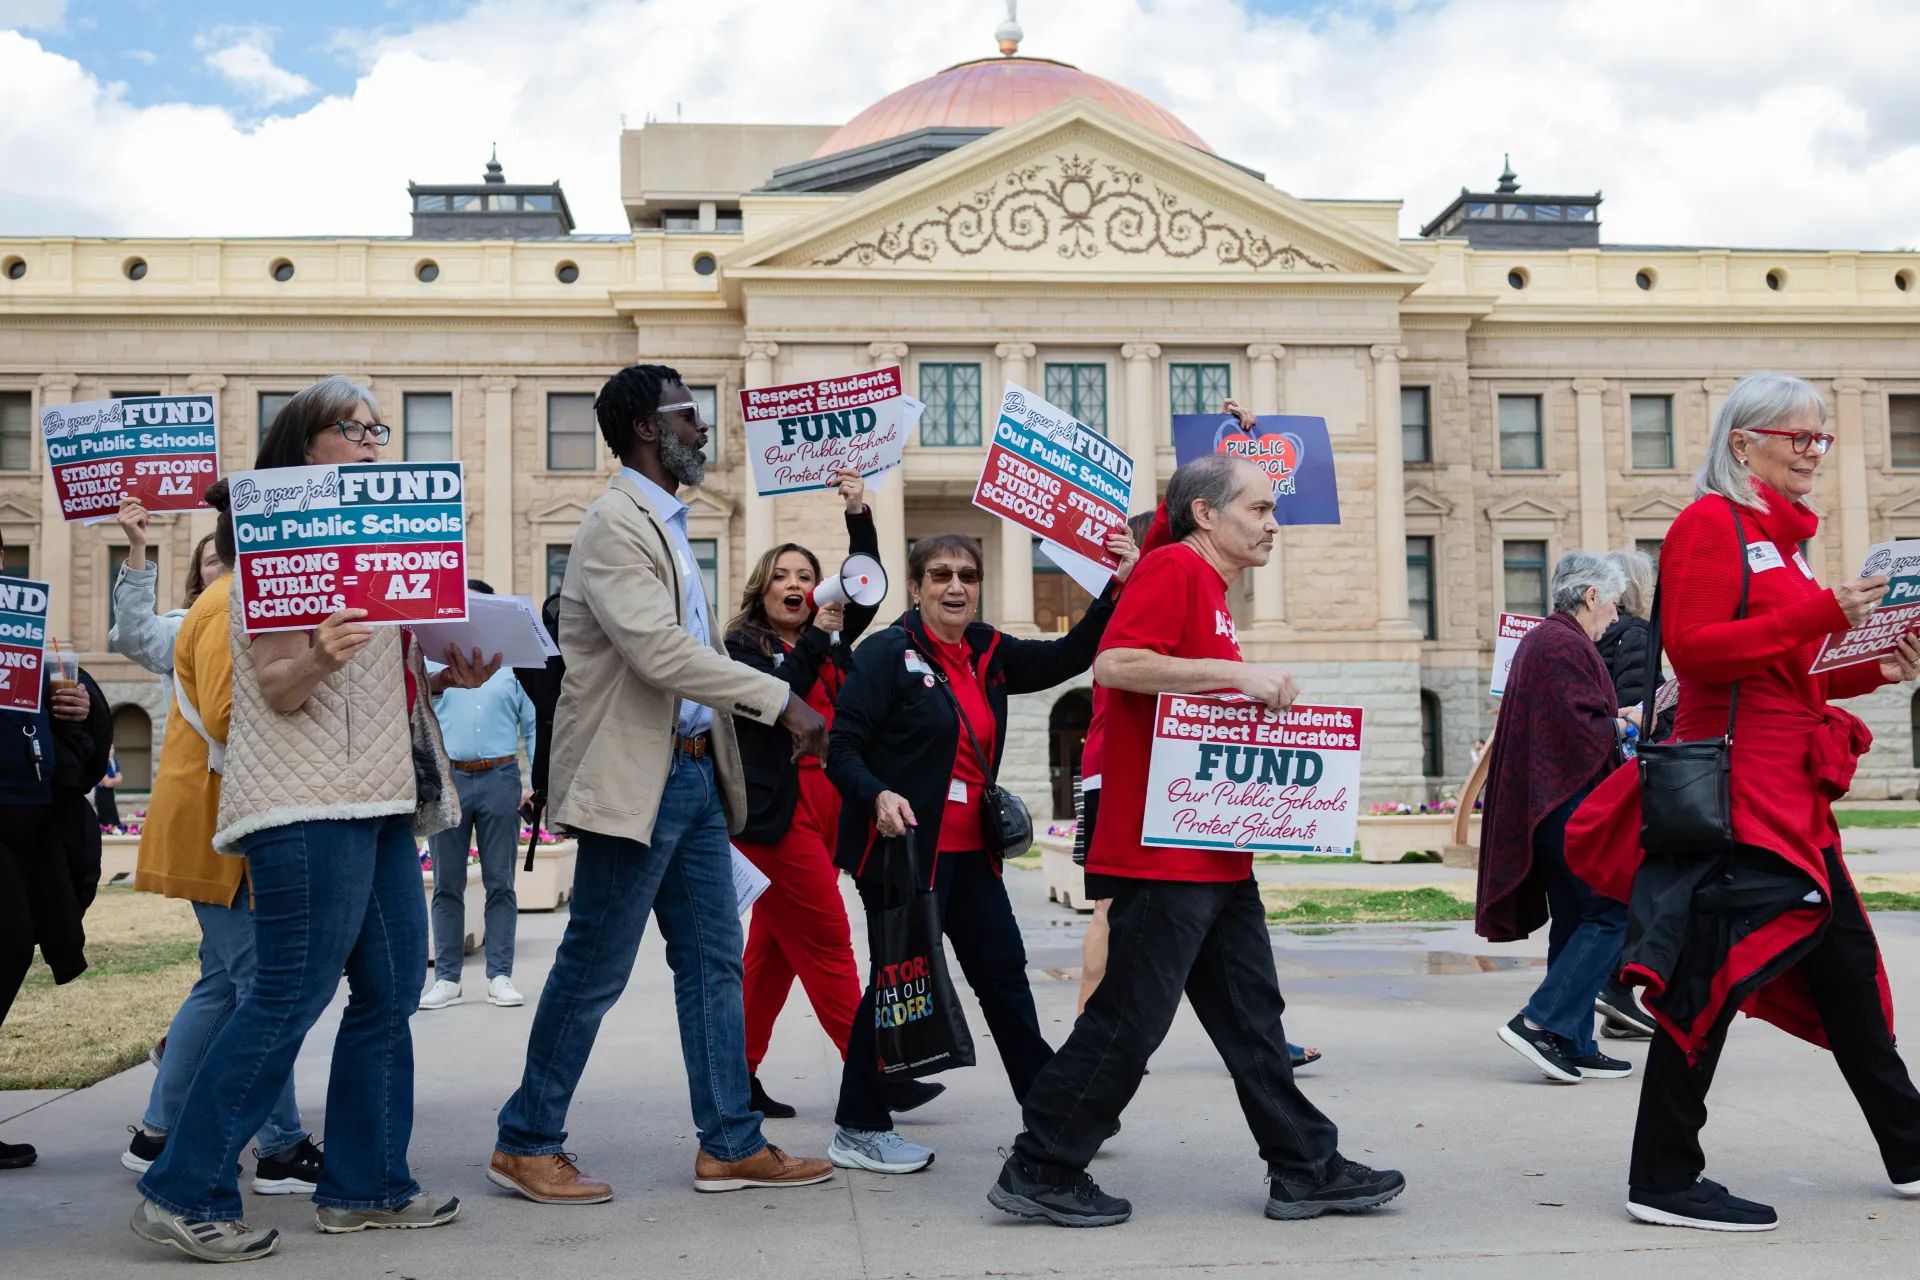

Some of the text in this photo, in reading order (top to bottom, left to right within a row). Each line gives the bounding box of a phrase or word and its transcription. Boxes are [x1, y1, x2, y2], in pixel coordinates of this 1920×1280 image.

[747, 400, 813, 419] Respect
[748, 384, 815, 405] Respect
[43, 403, 125, 440] Do your job!
[123, 401, 213, 427] FUND
[778, 406, 877, 446] FUND
[1003, 391, 1078, 443] Do your job!
[50, 431, 215, 459] Our Public Schools
[764, 423, 897, 465] Our Public Schools
[1072, 429, 1132, 484] FUND
[1226, 439, 1286, 457] PUBLIC
[61, 461, 124, 483] STRONG
[134, 459, 213, 476] STRONG
[774, 452, 880, 487] Protect Stdents
[997, 452, 1062, 496] STRONG
[998, 422, 1129, 508] Our Public Schools
[67, 476, 121, 497] PUBLIC
[158, 475, 193, 496] AZ
[232, 471, 343, 518] Do your job!
[340, 470, 461, 503] FUND
[995, 470, 1055, 509] PUBLIC
[981, 482, 1056, 529] SCHOOLS
[238, 512, 463, 544] Our Public Schools
[1076, 516, 1107, 547] AZ
[251, 552, 340, 578] STRONG
[355, 551, 459, 573] STRONG
[1861, 548, 1892, 579] Do
[0, 583, 47, 613] ND
[257, 574, 336, 598] PUBLIC
[385, 573, 432, 601] AZ
[248, 593, 346, 619] SCHOOLS
[1840, 621, 1911, 646] PUBLIC
[1170, 698, 1258, 724] Respect
[1162, 716, 1358, 748] Respect Educators.
[1195, 743, 1324, 788] FUND
[1167, 777, 1348, 819] Our Public Schools
[1172, 808, 1317, 848] Protect Students
